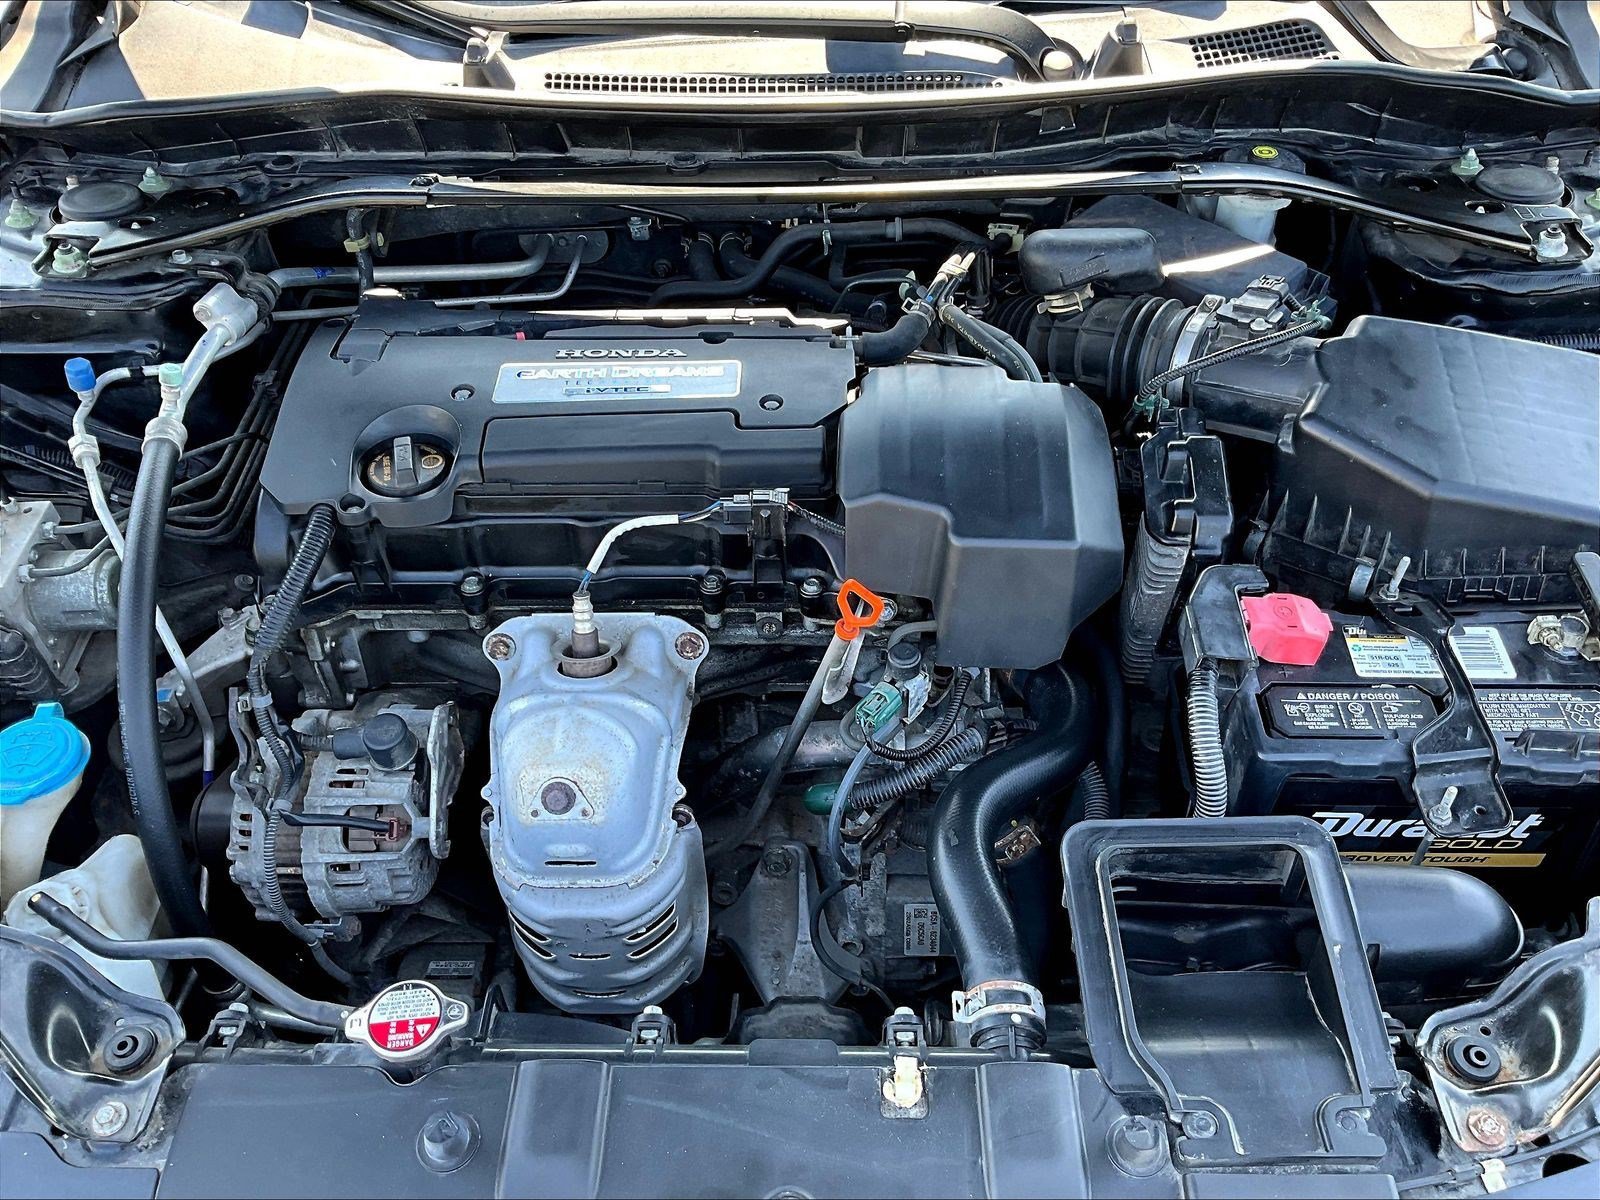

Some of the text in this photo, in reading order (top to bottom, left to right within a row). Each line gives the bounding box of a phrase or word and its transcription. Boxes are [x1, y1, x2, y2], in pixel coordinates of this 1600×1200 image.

[555, 348, 687, 358] HONDA
[516, 368, 606, 380] EARTH
[1307, 692, 1350, 700] DANGER
[1360, 692, 1399, 700] POISON
[386, 1038, 414, 1049] DANGER
